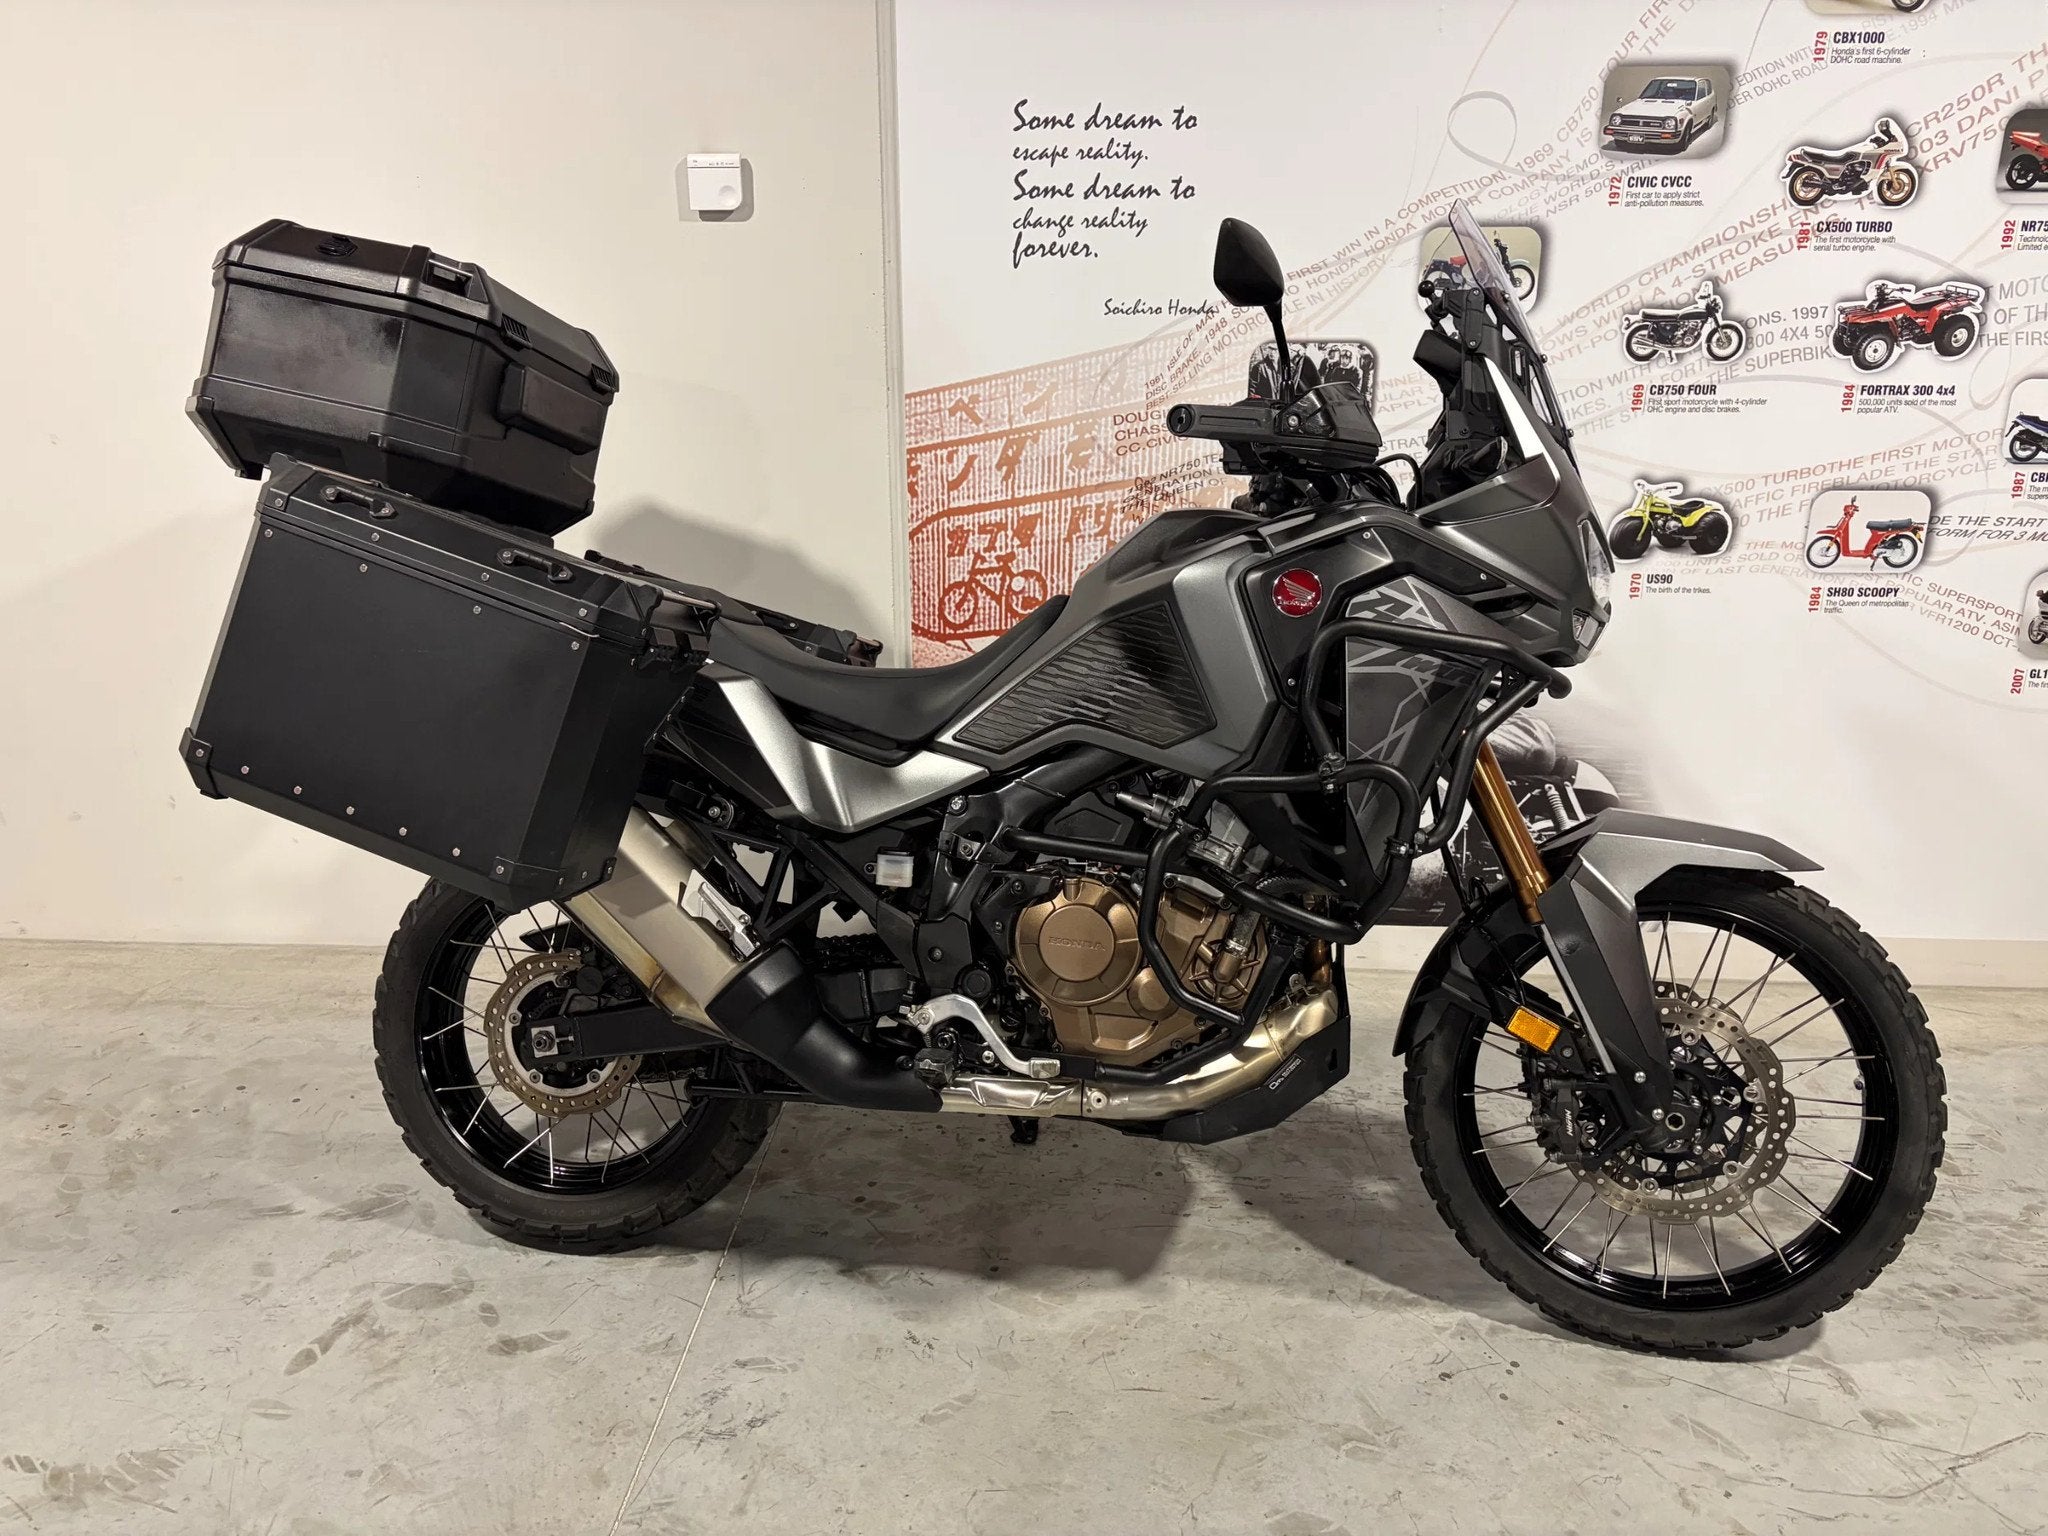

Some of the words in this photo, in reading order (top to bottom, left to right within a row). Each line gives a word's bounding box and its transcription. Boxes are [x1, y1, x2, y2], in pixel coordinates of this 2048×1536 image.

[1813, 31, 1828, 63] 1979
[1833, 31, 1885, 44] CBX1000
[1830, 55, 1853, 63] DOHC
[1854, 55, 1870, 63] road
[1871, 55, 1903, 64] machine.
[1861, 47, 1875, 56] first
[1737, 57, 1785, 87] EDITION
[1753, 76, 1790, 98] DOHC
[1792, 59, 1829, 81] ROAD
[1013, 99, 1075, 132] Some
[1084, 102, 1162, 131] dream
[1172, 105, 1198, 130] to
[1905, 72, 2006, 139] CR250R
[1956, 85, 2021, 134] DANI
[1013, 146, 1069, 168] escape
[1076, 138, 1149, 169] reality.
[1013, 169, 1075, 201] Some
[1083, 173, 1161, 200] dream
[1170, 176, 1196, 200] to
[1544, 160, 1617, 206] WORLD'S
[1608, 176, 1622, 206] 1972
[1628, 176, 1658, 188] CIVIC
[1661, 176, 1692, 188] CVCC
[1626, 191, 1641, 199] First
[1655, 191, 1662, 199] to
[1663, 191, 1683, 201] apply
[1684, 191, 1700, 199] strict
[1145, 381, 1168, 401] DISC
[1170, 348, 1203, 384] BRAKE.
[1204, 318, 1229, 345] 1948
[1306, 257, 1360, 290] HONDA
[1363, 222, 1418, 258] HONDA
[1488, 151, 1573, 200] COMPANY
[1575, 127, 1594, 148] IS
[1638, 15, 1676, 55] THE
[1182, 329, 1195, 350] OF
[1195, 305, 1221, 333] MAN
[1286, 259, 1328, 282] FIRST
[1333, 239, 1363, 265] WIN
[1364, 226, 1381, 243] IN
[1385, 217, 1398, 230] A
[1398, 169, 1512, 220] COMPETITION.
[1515, 142, 1554, 173] 1969
[1556, 82, 1600, 143] CB750
[1545, 194, 1581, 221] NSR
[1625, 199, 1670, 208] anti-pollution
[1671, 199, 1704, 208] measures.
[1012, 207, 1074, 238] change
[1081, 206, 1148, 237] reality
[2001, 220, 2016, 250] 1992
[1797, 221, 1811, 250] 1981
[1816, 221, 1852, 233] CX500
[1855, 221, 1893, 233] TURBO
[1813, 243, 1829, 252] serial
[1830, 243, 1850, 251] turbo
[1851, 244, 1876, 253] engine.
[1814, 235, 1827, 244] The
[1828, 235, 1842, 244] first
[1843, 235, 1881, 246] motorcycle
[1882, 235, 1896, 244] with
[2017, 243, 2042, 251] Limited
[1012, 231, 1099, 269] forever.
[1593, 302, 1642, 330] WITH
[1652, 286, 1668, 302] A
[1671, 222, 1784, 290] 4-STROKE
[1104, 298, 1163, 316] Soichiro
[1168, 298, 1215, 316] Honda
[1556, 283, 1631, 328] WORLD
[1792, 305, 1829, 320] 1997
[1994, 306, 2019, 325] OF
[1145, 352, 1213, 411] BEST-SELLING
[1308, 287, 1326, 306] IN
[1326, 251, 1395, 299] HISTORY.
[1779, 325, 1811, 341] 4X4
[1978, 330, 2010, 348] THE
[1607, 363, 1652, 387] WITH
[1581, 412, 1617, 437] THE
[1705, 366, 1742, 391] THE
[1631, 384, 1645, 412] 1969
[1650, 384, 1685, 396] CB750
[1688, 384, 1717, 396] FOUR
[1647, 406, 1664, 414] OHC
[1665, 406, 1686, 415] engine
[1687, 406, 1700, 414] and
[1702, 406, 1714, 414] disc
[1715, 406, 1741, 414] brakes.
[1648, 398, 1662, 406] First
[1663, 398, 1681, 408] sport
[1682, 398, 1718, 408] motorcycle
[1719, 398, 1734, 406] with
[1735, 398, 1767, 408] 4-cylinder
[1841, 384, 1855, 412] 1984
[1860, 385, 1910, 396] FORTRAX
[1912, 385, 1933, 396] 300
[1936, 385, 1955, 396] 4x4
[1857, 406, 1881, 415] popular
[1882, 406, 1899, 414] ATV.
[1858, 399, 1886, 407] 500,000
[1887, 399, 1903, 407] units
[1904, 399, 1917, 407] sold
[1918, 399, 1926, 407] of
[1927, 399, 1936, 407] the
[1938, 399, 1957, 407] most
[1869, 443, 1926, 466] FIRST
[1159, 458, 1201, 482] NR750
[1790, 463, 1896, 497] FIREBLADE
[1904, 454, 1941, 473] THE
[2011, 472, 2025, 498] 1987
[2029, 485, 2041, 493] The
[1757, 502, 1797, 524] THE
[1957, 515, 1991, 527] THE
[1993, 516, 2048, 529] START
[1745, 540, 1777, 551] THE
[1978, 528, 2014, 540] FOR
[2013, 530, 2028, 541] 3
[1739, 551, 1780, 565] SOLD
[1629, 573, 1642, 599] 1970
[1647, 573, 1673, 585] US90
[1704, 565, 1748, 576] LAST
[1748, 562, 1846, 588] GENERATION
[1646, 586, 1657, 594] The
[1658, 586, 1673, 594] birth
[1674, 586, 1681, 594] of
[1682, 586, 1692, 594] the
[1693, 586, 1711, 594] trikes.
[1808, 587, 1822, 613] 1984
[1826, 587, 1855, 598] SH80
[1857, 587, 1900, 598] SCOOPY
[1885, 579, 1953, 613] POPULAR
[1955, 606, 1987, 625] ATV.
[1926, 581, 2023, 623] SUPERSPORT
[1824, 607, 1843, 615] traffic.
[1826, 600, 1838, 608] The
[1839, 600, 1859, 608] Queen
[1860, 600, 1868, 608] of
[1869, 600, 1909, 609] metropolitan
[1919, 608, 1980, 637] VFR1200
[2010, 668, 2025, 695] 2007
[2028, 680, 2039, 688] The
